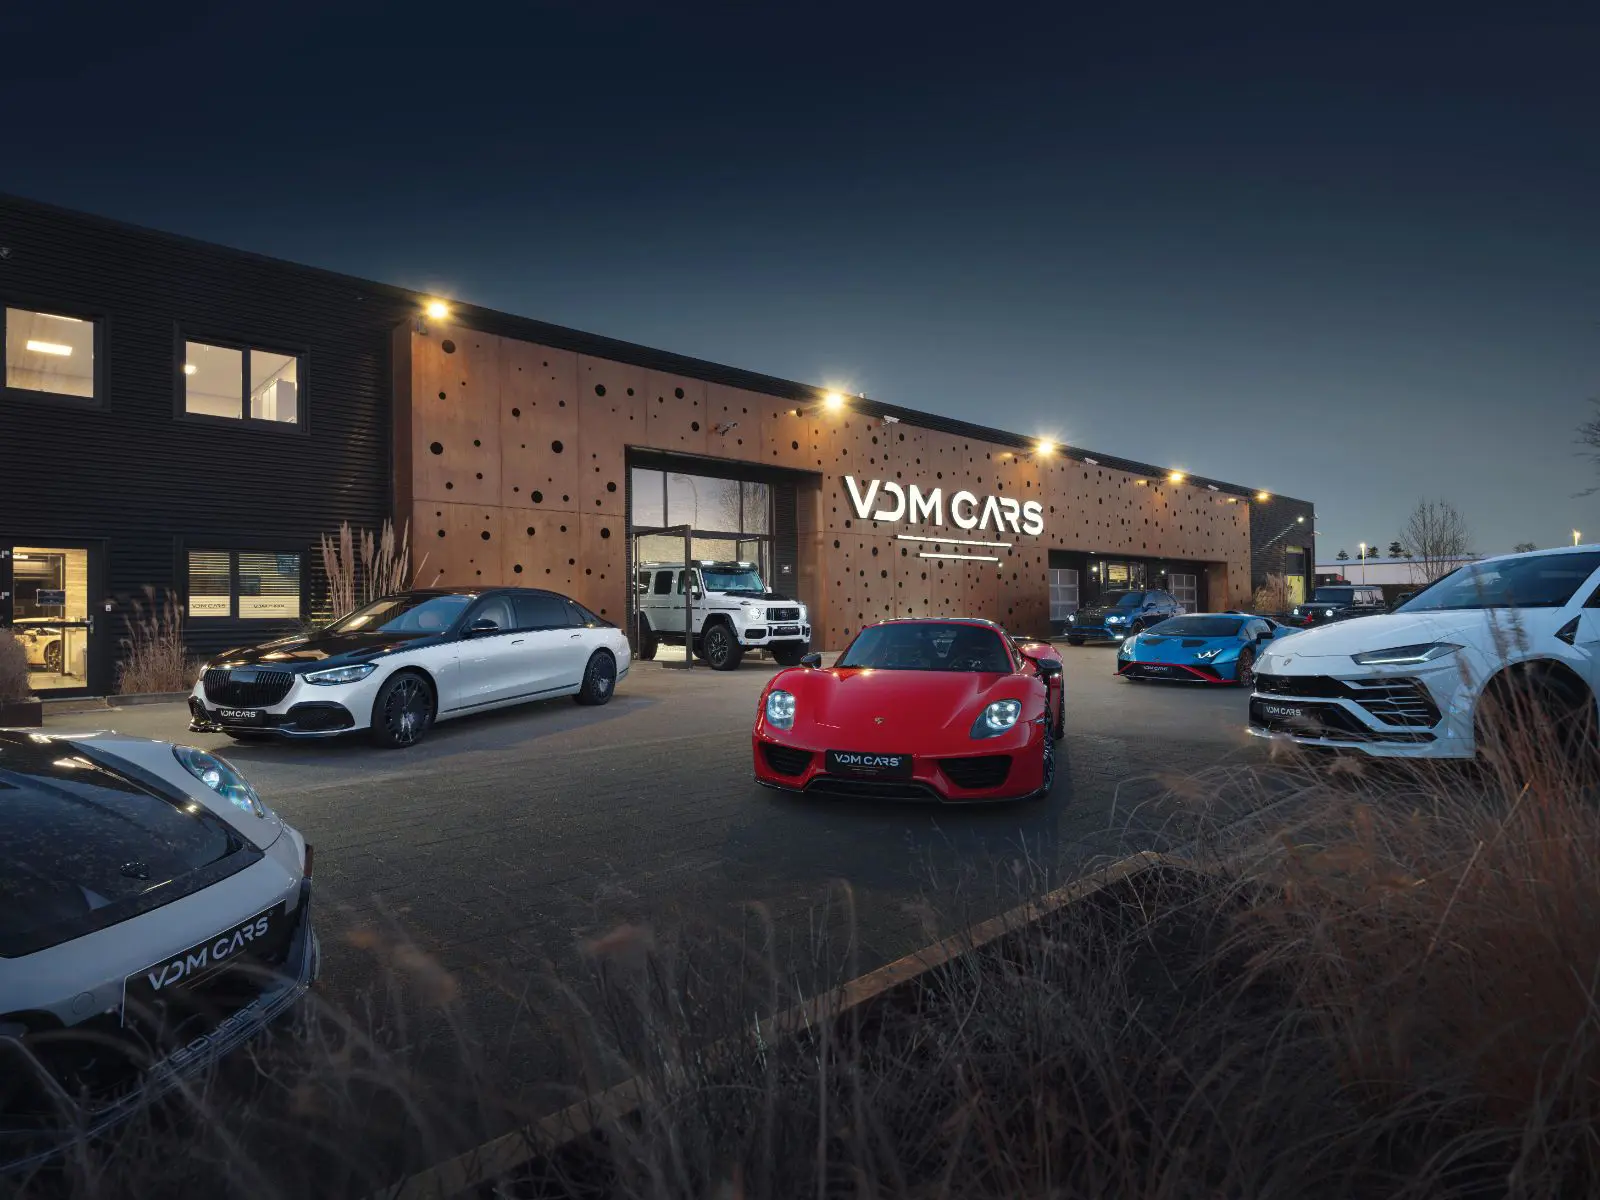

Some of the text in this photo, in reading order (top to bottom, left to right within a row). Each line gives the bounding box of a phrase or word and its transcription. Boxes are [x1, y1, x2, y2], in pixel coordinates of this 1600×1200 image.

[843, 475, 1044, 536] VDM CARS
[235, 710, 256, 718] CARS
[1265, 706, 1302, 716] VDM CARS
[834, 753, 899, 767] VDM CARS
[147, 916, 269, 991] VDM CARS
